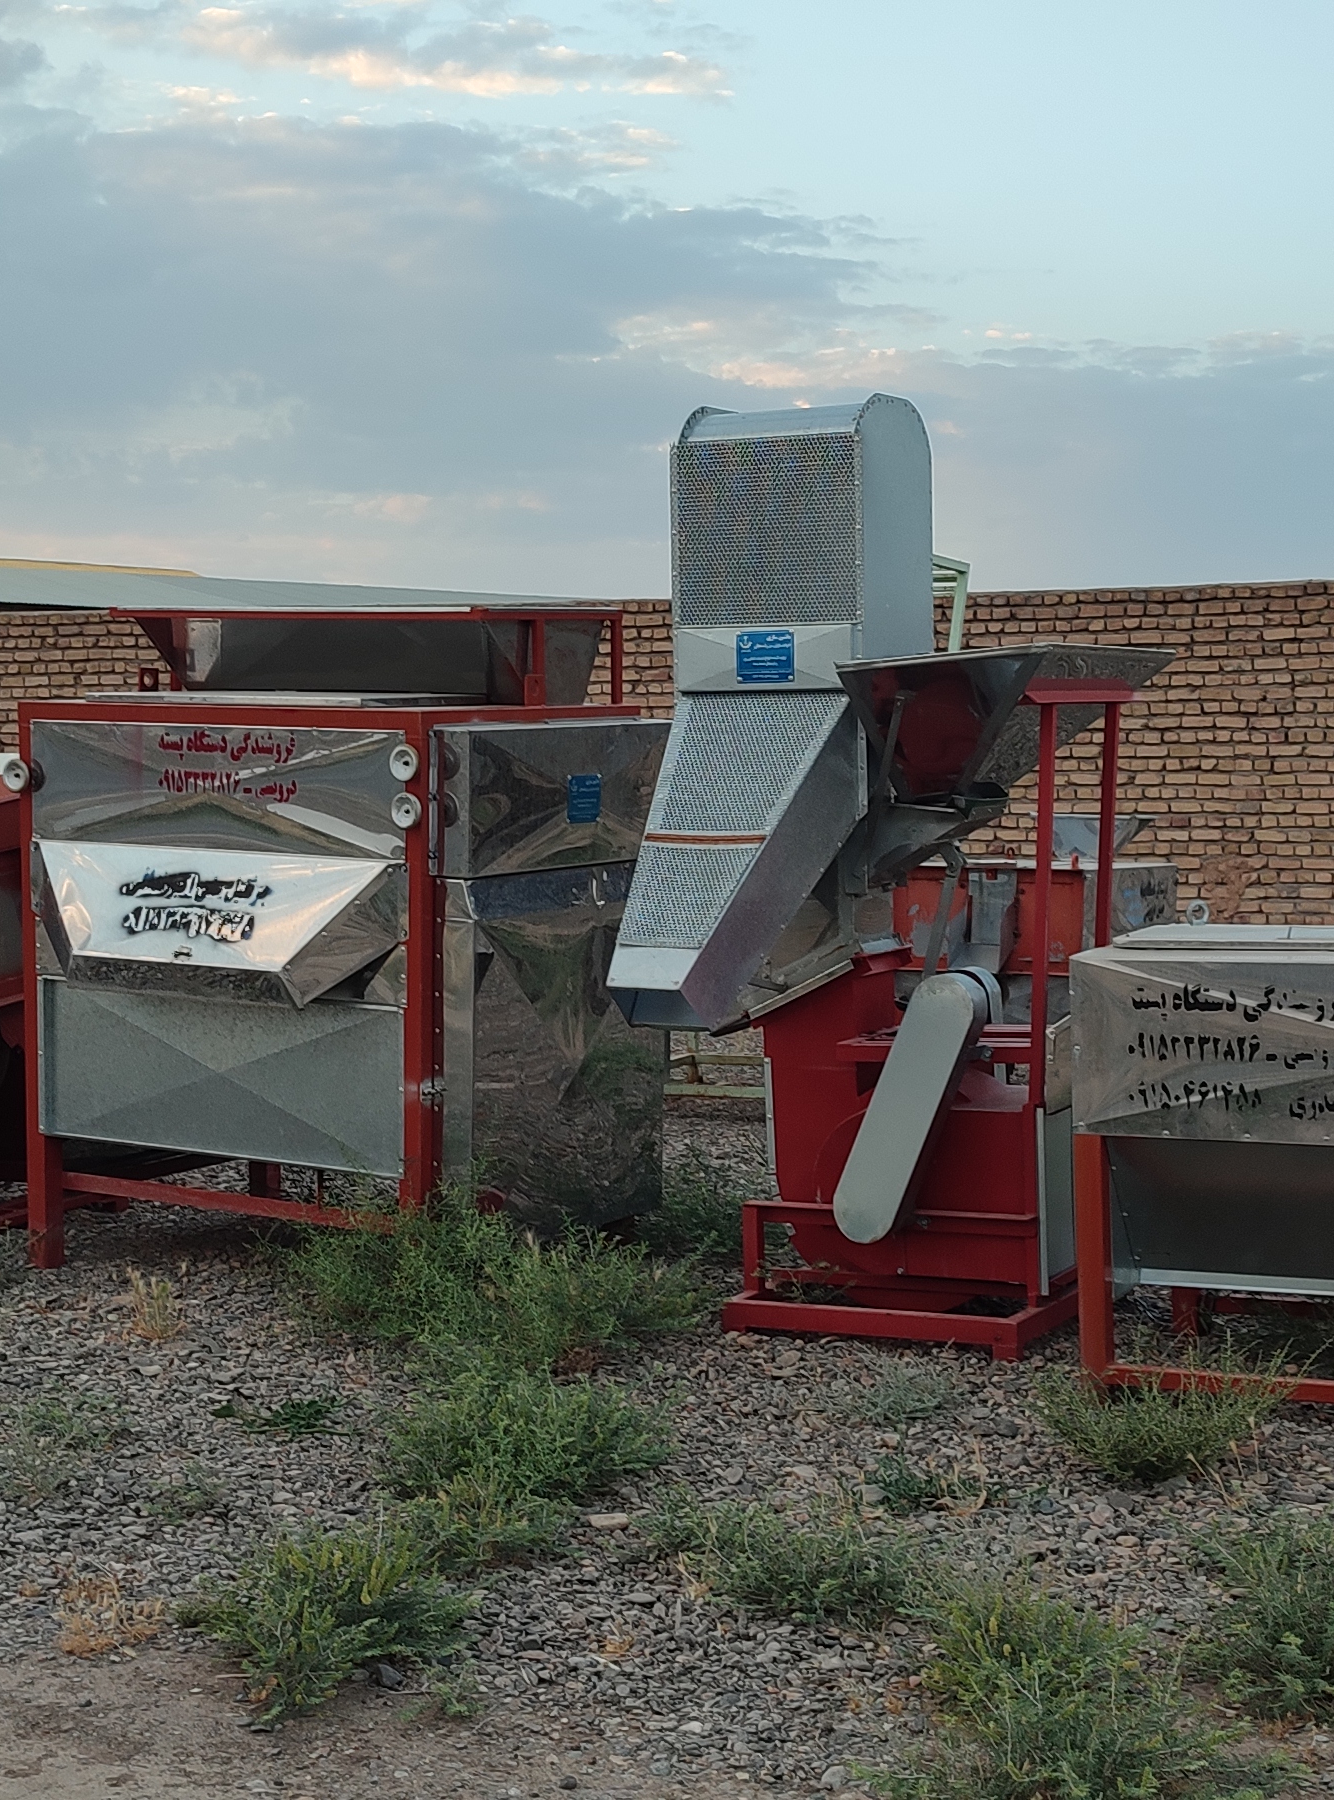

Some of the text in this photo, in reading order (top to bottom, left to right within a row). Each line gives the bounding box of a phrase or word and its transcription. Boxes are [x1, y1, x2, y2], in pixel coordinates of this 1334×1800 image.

[158, 729, 296, 763] فروشندگی دستگاه پسته
[1172, 983, 1237, 1012] دستگاه
